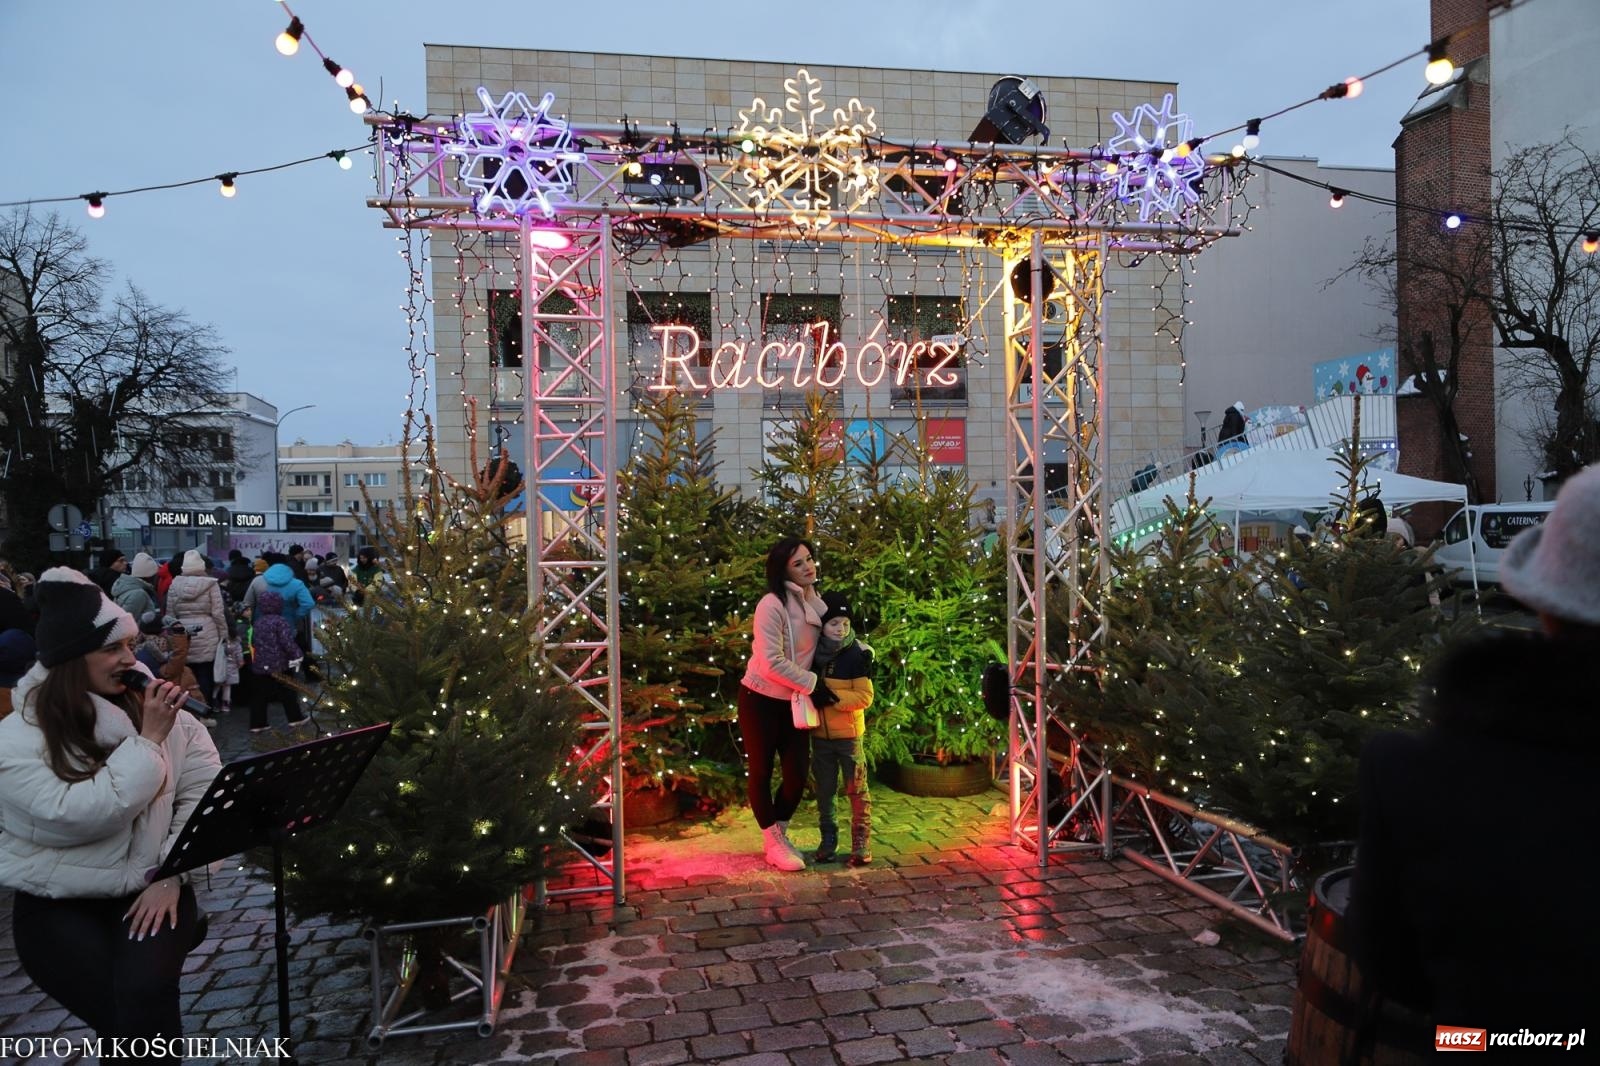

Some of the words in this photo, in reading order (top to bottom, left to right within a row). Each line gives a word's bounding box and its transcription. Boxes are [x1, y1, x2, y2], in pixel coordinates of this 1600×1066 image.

[649, 321, 959, 390] Racibórz
[154, 512, 189, 525] DREAM
[198, 513, 228, 526] DAN
[236, 514, 263, 527] STUDIO
[1507, 516, 1539, 526] CATERING
